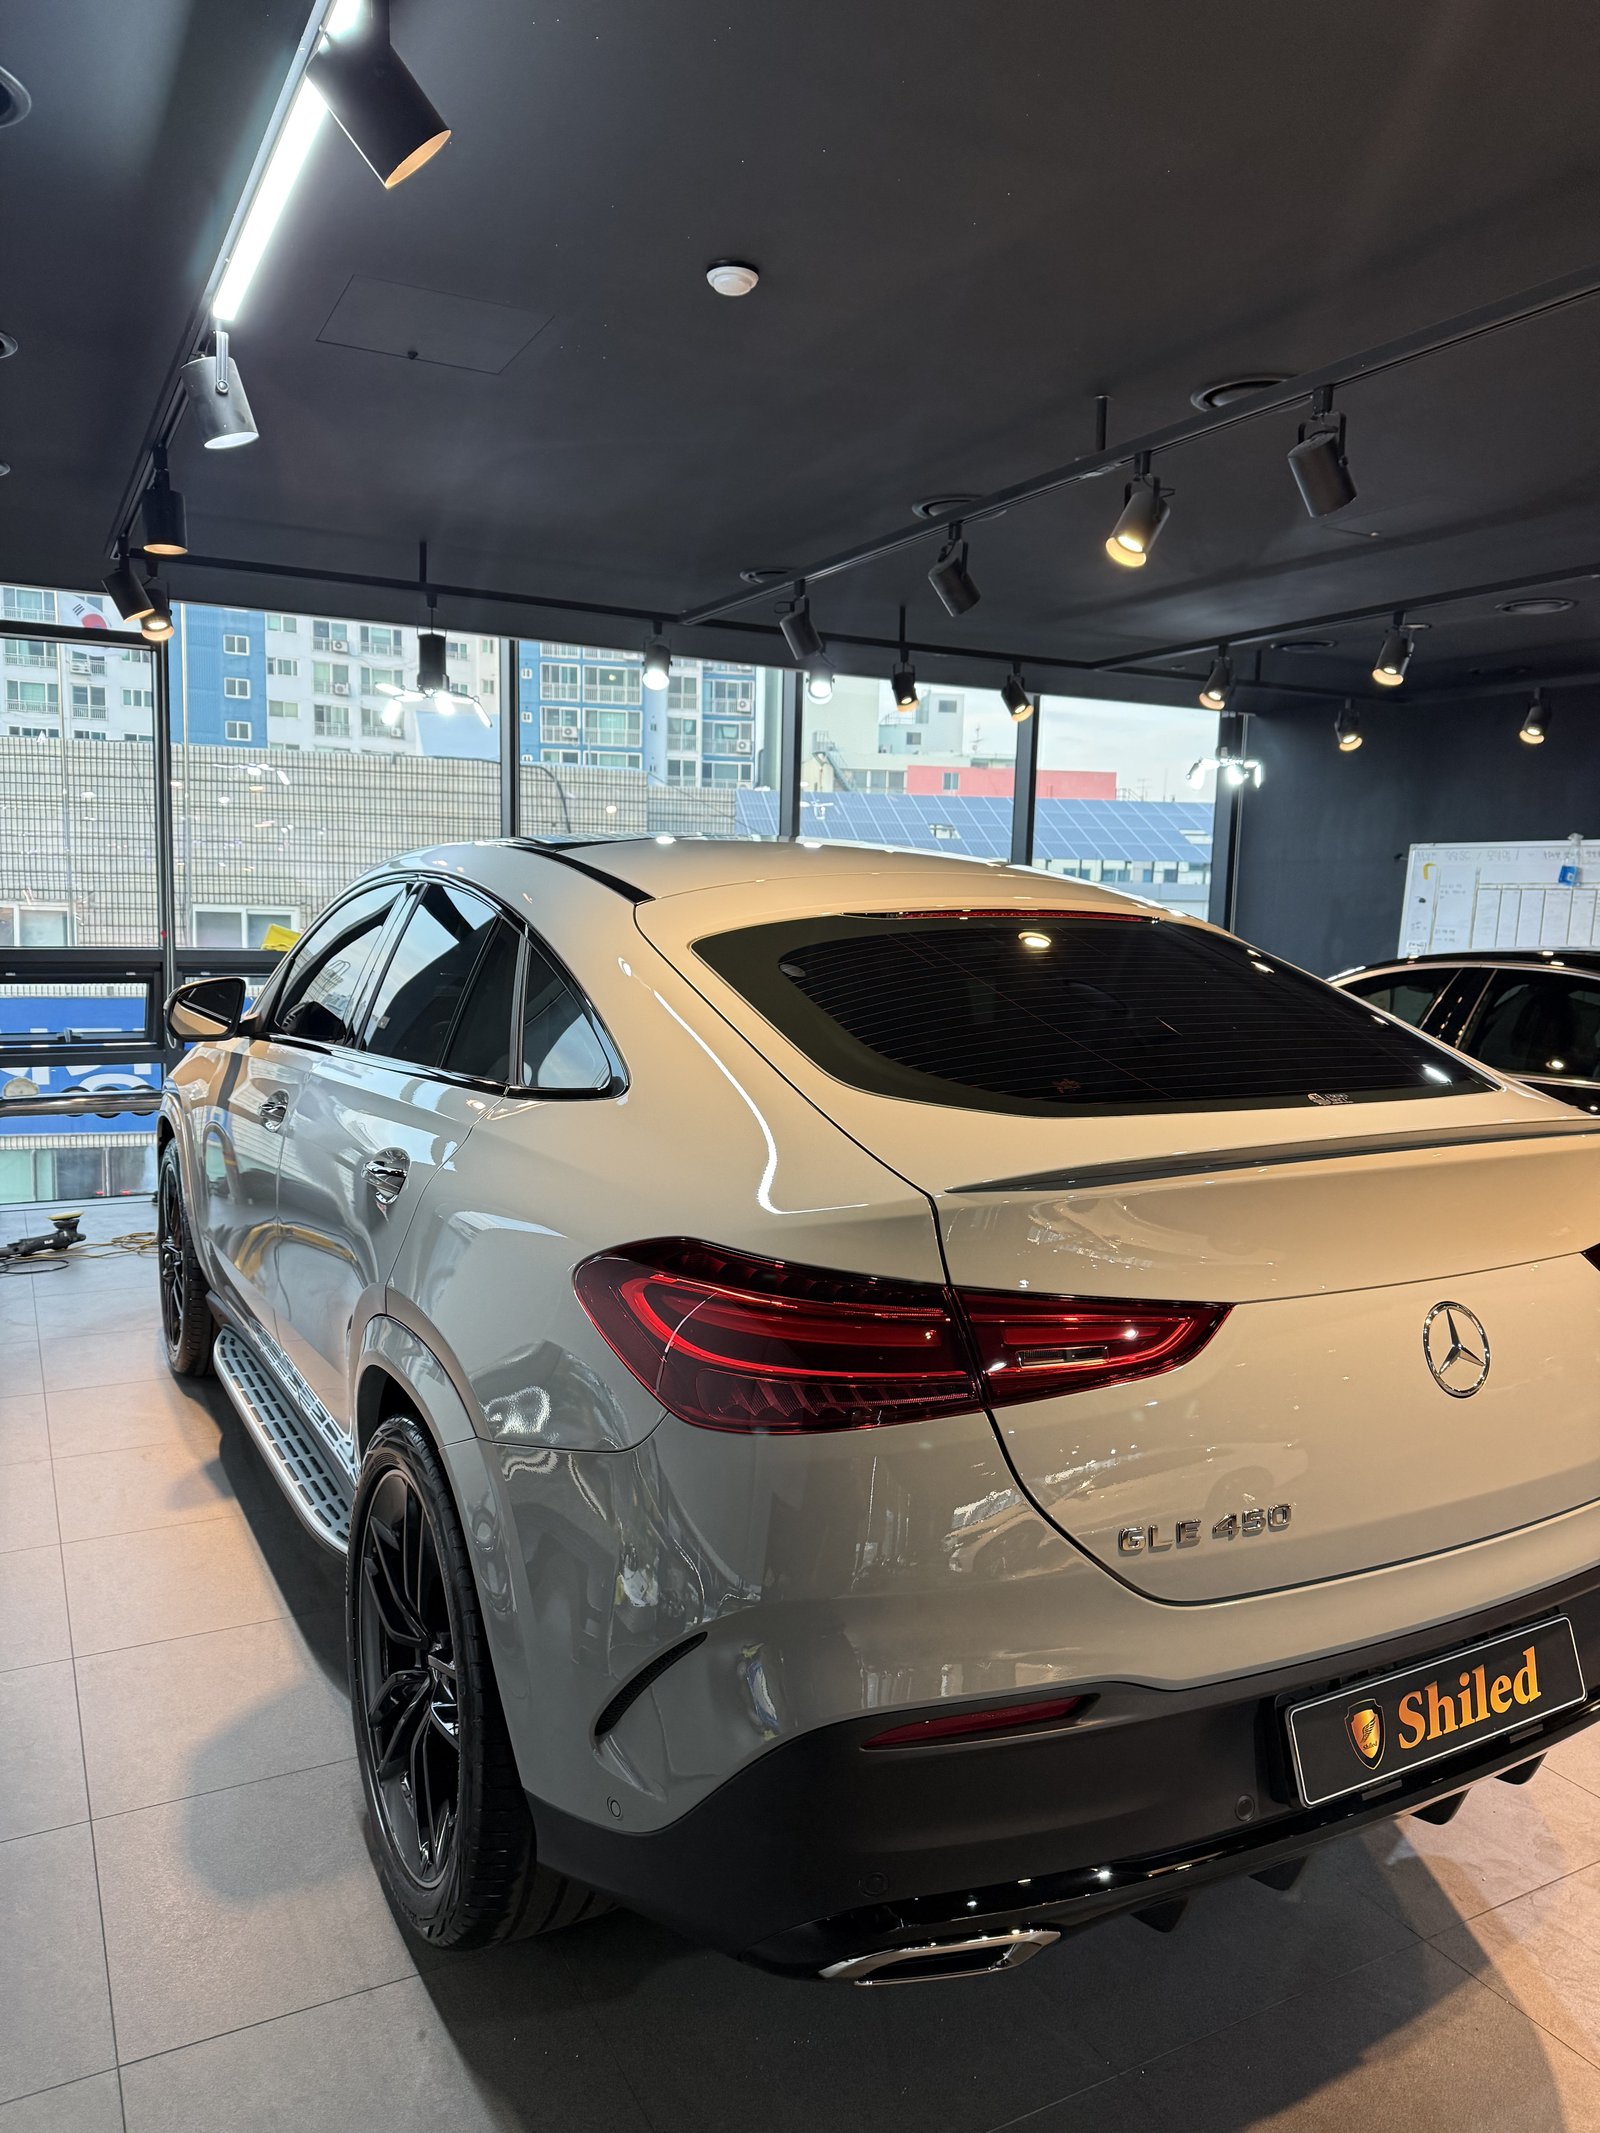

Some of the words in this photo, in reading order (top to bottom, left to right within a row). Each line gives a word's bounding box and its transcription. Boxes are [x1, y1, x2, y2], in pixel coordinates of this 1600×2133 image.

[1118, 1519, 1201, 1553] GLE
[1212, 1503, 1292, 1539] 450
[1398, 1646, 1541, 1749] Shiled
